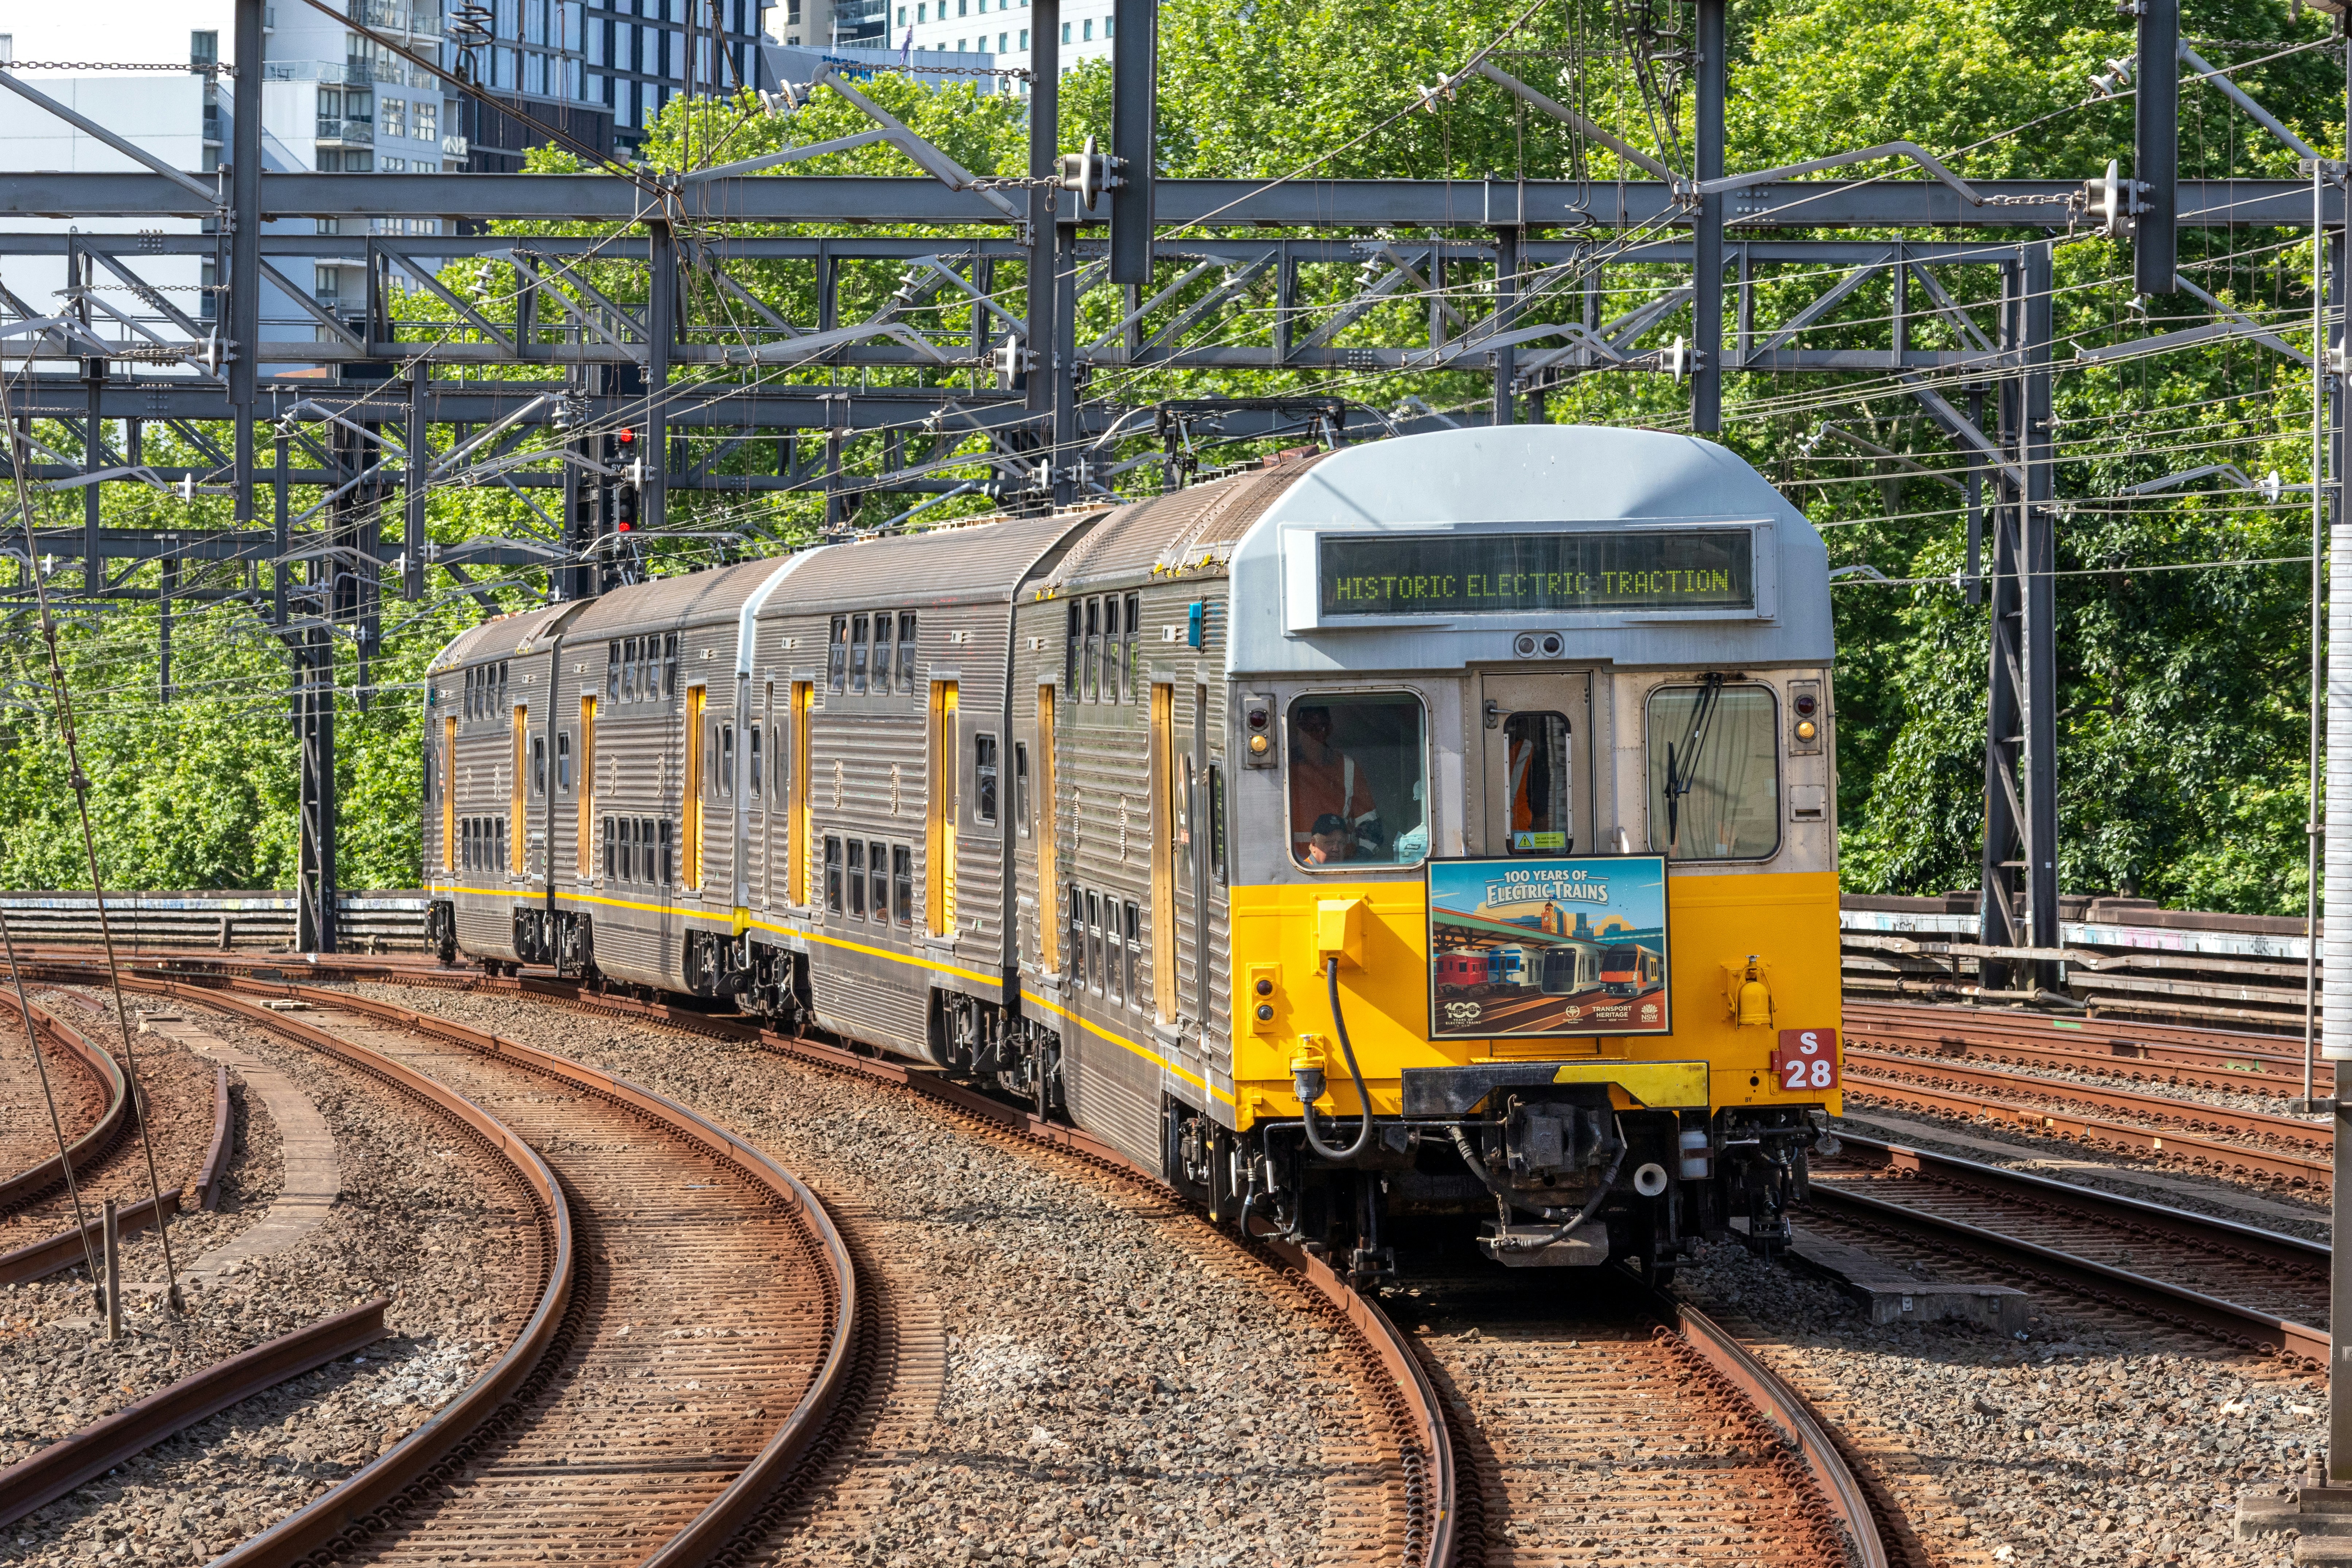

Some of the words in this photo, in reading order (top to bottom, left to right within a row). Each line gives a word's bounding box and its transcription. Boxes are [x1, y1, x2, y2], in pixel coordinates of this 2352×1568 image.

[1337, 575, 1456, 600] HISTORIC
[1467, 572, 1589, 597] ELECTRIC
[1601, 569, 1728, 593] TRACTION
[1504, 870, 1530, 883] 100
[1533, 870, 1569, 881] YEARS
[1572, 870, 1588, 881] OF
[1486, 884, 1549, 907] ELECTRIC
[1552, 881, 1608, 902] TRAINS
[1444, 1002, 1480, 1018] 100
[1800, 1032, 1818, 1055] S
[1786, 1060, 1831, 1087] 28
